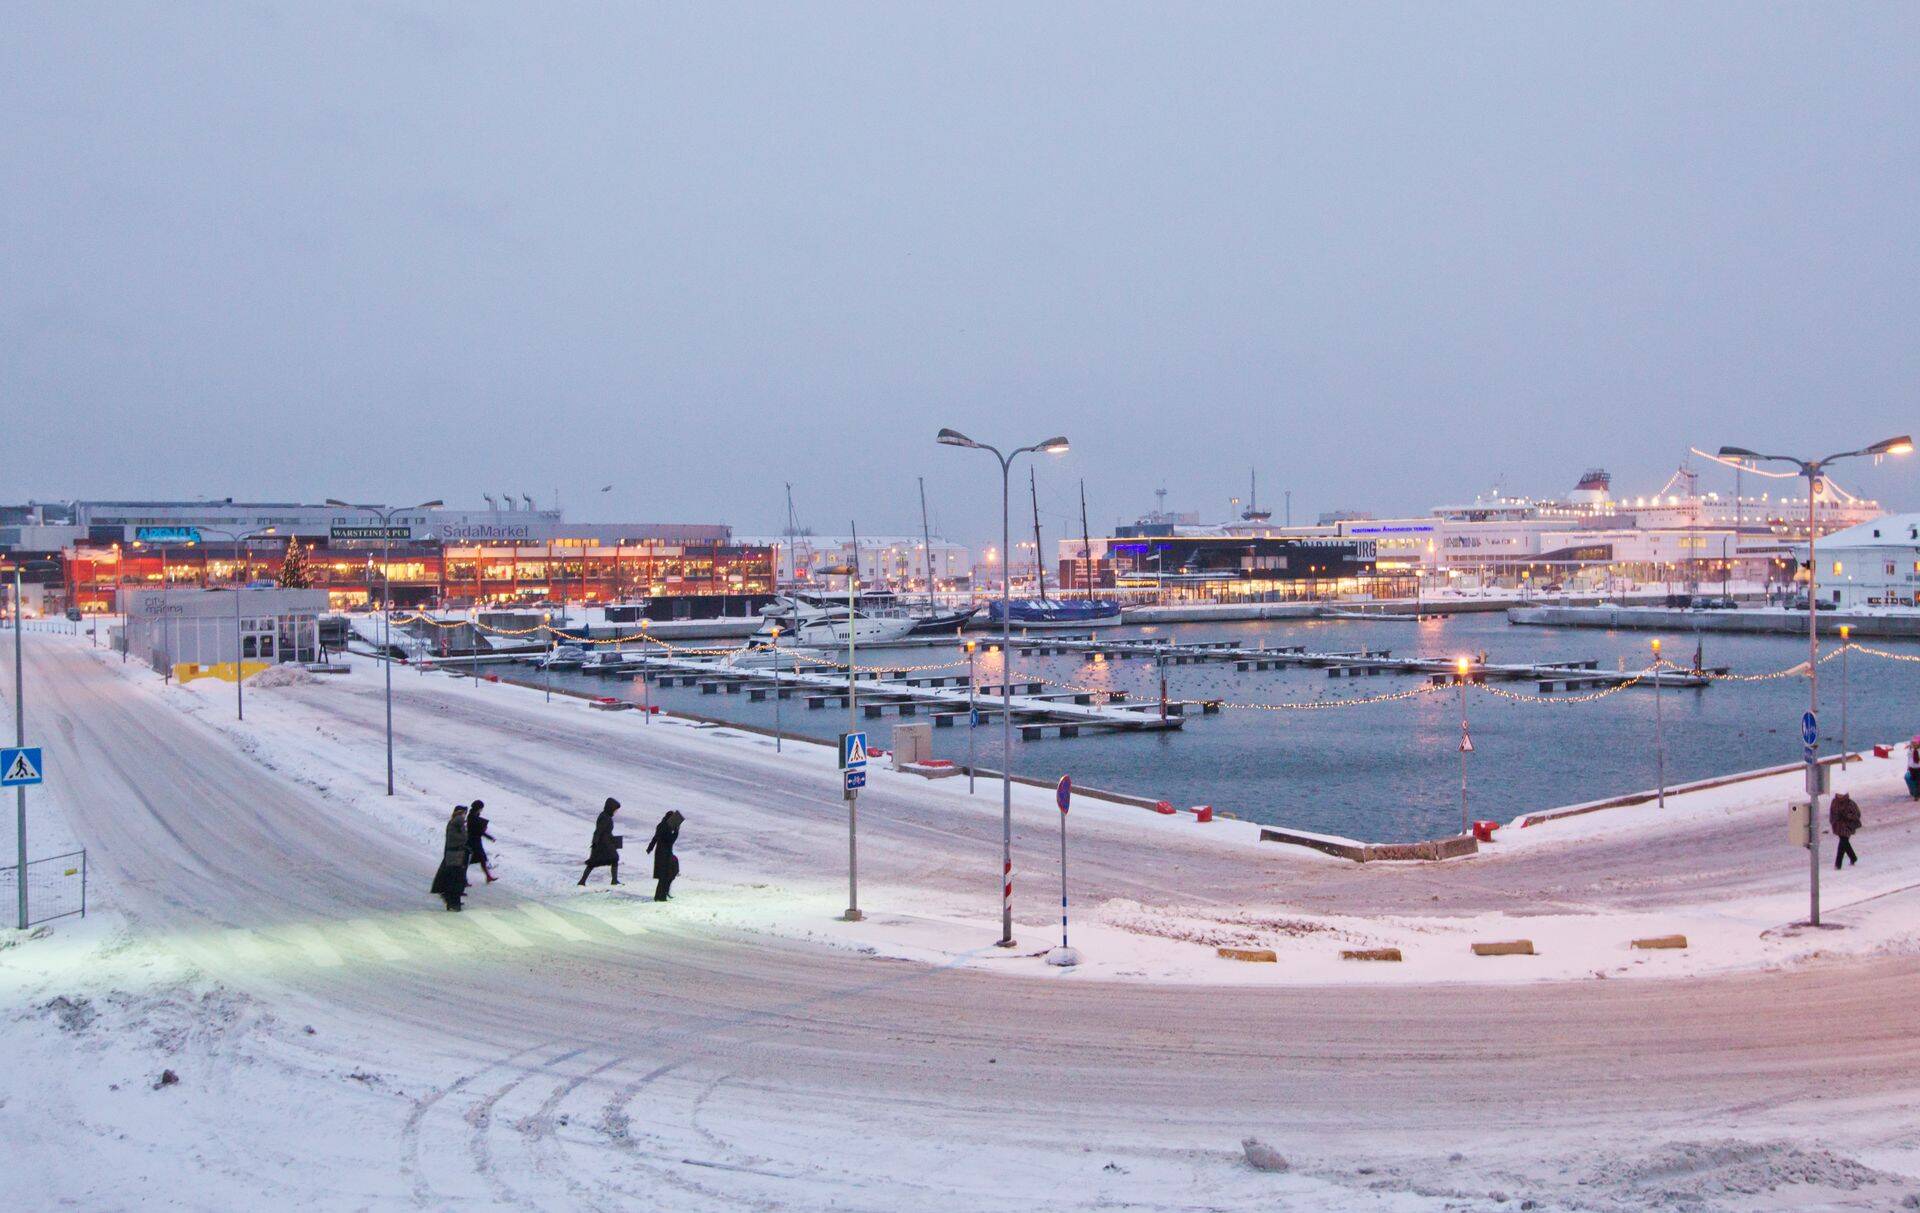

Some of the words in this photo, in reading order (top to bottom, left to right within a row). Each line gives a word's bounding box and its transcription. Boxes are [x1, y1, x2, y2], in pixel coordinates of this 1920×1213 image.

[333, 529, 390, 537] WARSTEINER
[392, 529, 409, 537] PUB
[443, 525, 529, 537] SadaMarket
